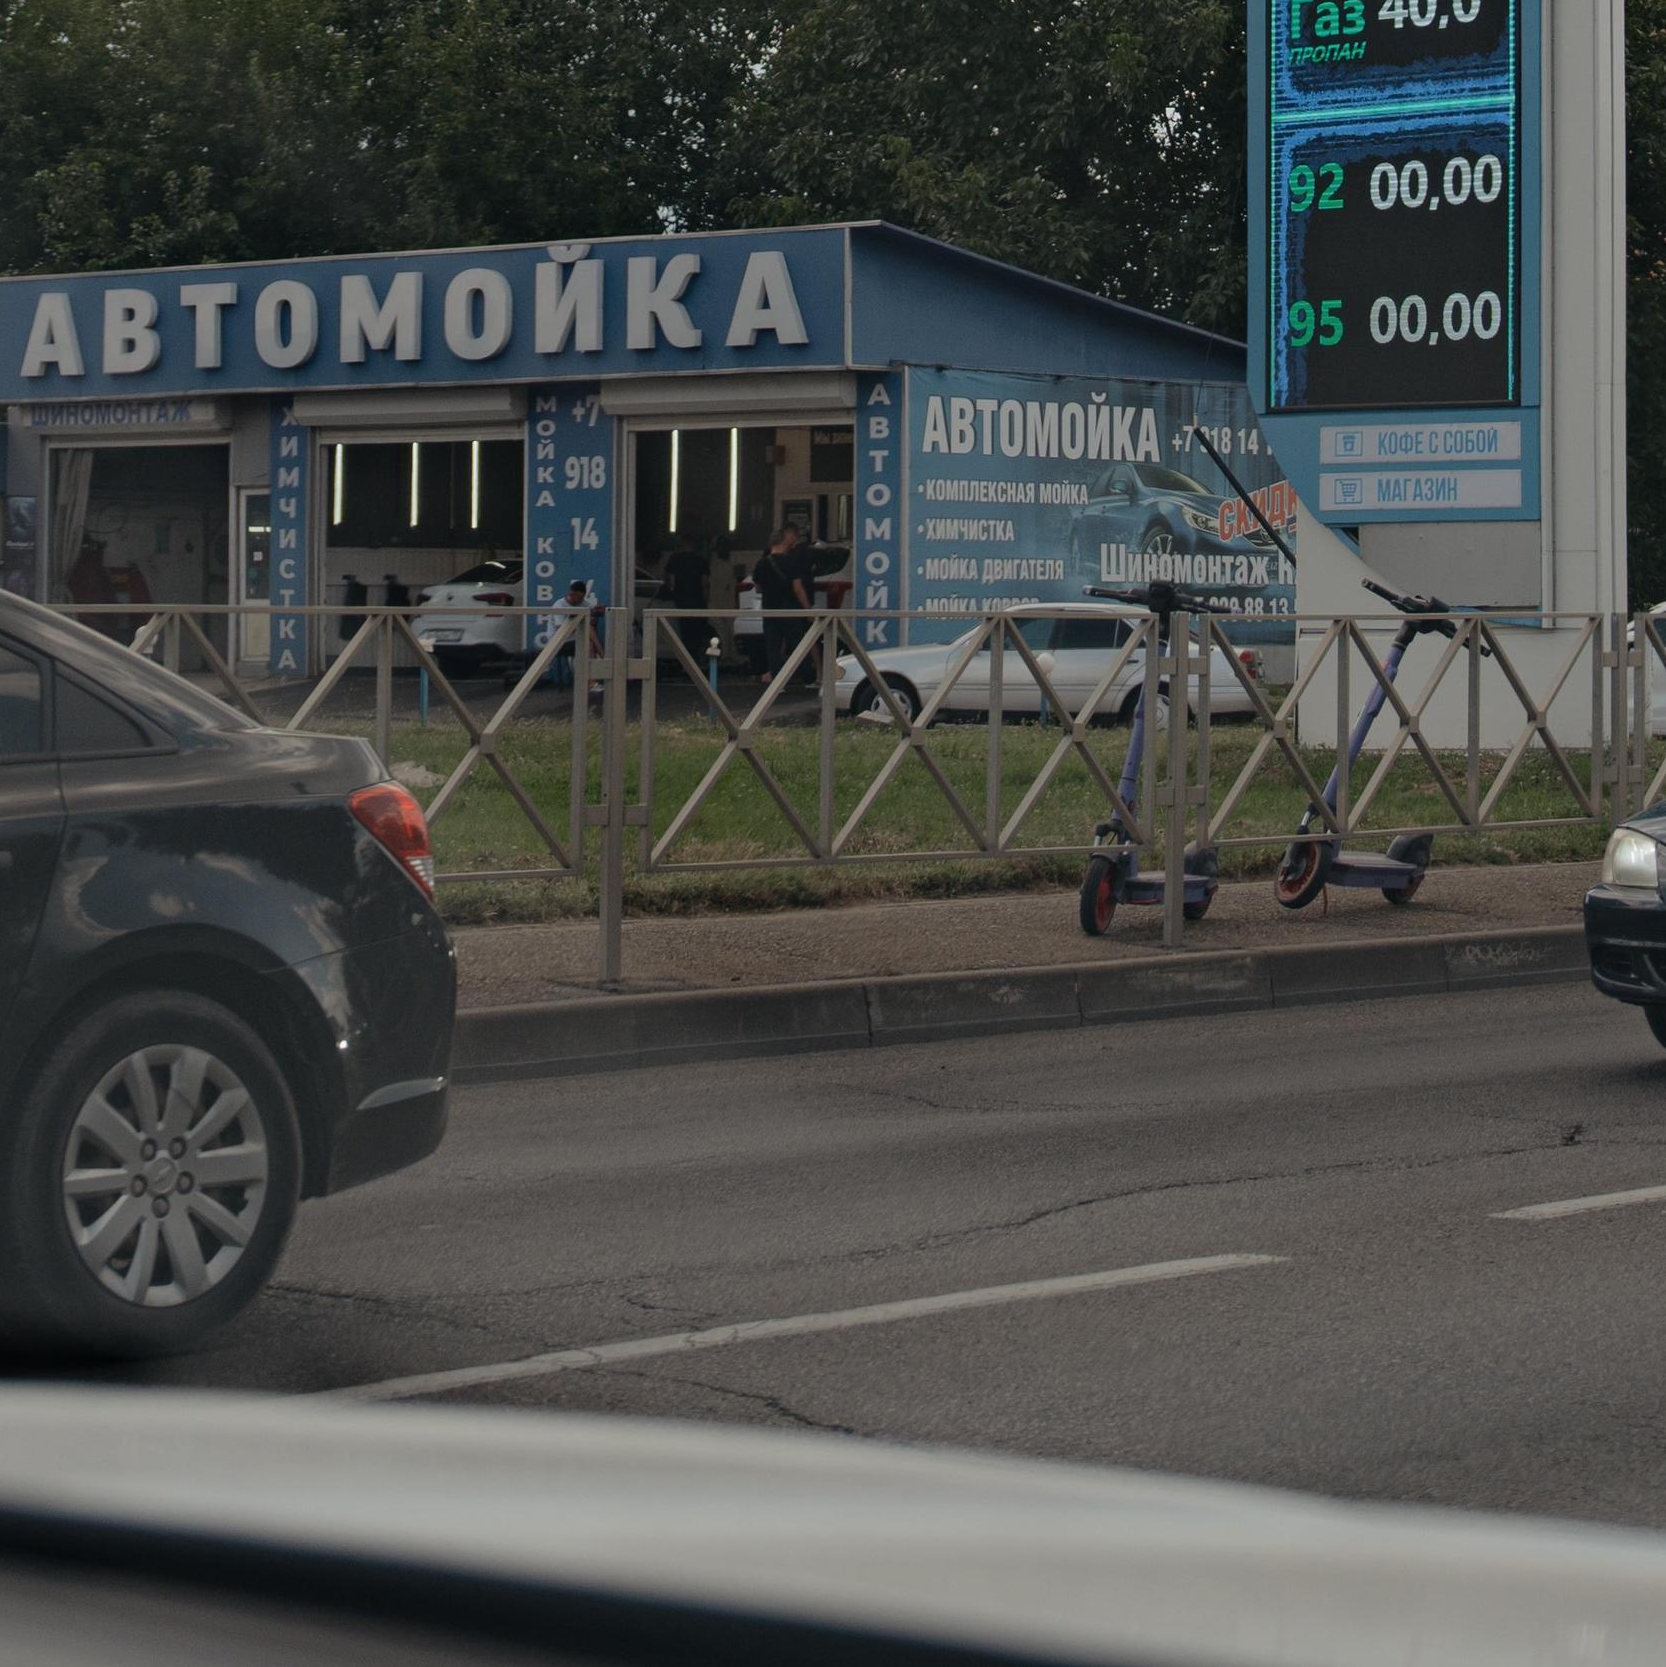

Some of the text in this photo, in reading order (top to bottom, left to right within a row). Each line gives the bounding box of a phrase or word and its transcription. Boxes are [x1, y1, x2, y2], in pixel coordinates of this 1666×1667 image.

[1288, 41, 1367, 65] ПРОПАН
[1288, 154, 1503, 213] 92 00,00
[20, 244, 809, 378] АВТОМОЙКА
[1288, 291, 1502, 347] 95 00,00
[29, 399, 191, 426] ШИНОМОНТАЖ
[572, 394, 601, 427] +7
[921, 391, 1161, 463] АВТОМОЙКА
[1237, 428, 1260, 455] 14
[535, 395, 558, 507] МОЙКА
[1377, 427, 1499, 456] КОФЕ С СОБОЙ
[564, 454, 607, 491] 918
[1377, 477, 1458, 503] МАГАЗИН
[926, 479, 1089, 505] КОМПЛЕКСНАЯ МОЙКА
[864, 383, 892, 645] АВТОМОЙК
[925, 518, 1015, 542] ХИМЧИСТКА
[277, 405, 300, 671] ХИМЧИСТКА
[570, 517, 600, 551] 14
[925, 554, 1064, 584] МОЙКА ДВИГАТЕЛЯ
[1100, 543, 1270, 585] Шиномонтаж
